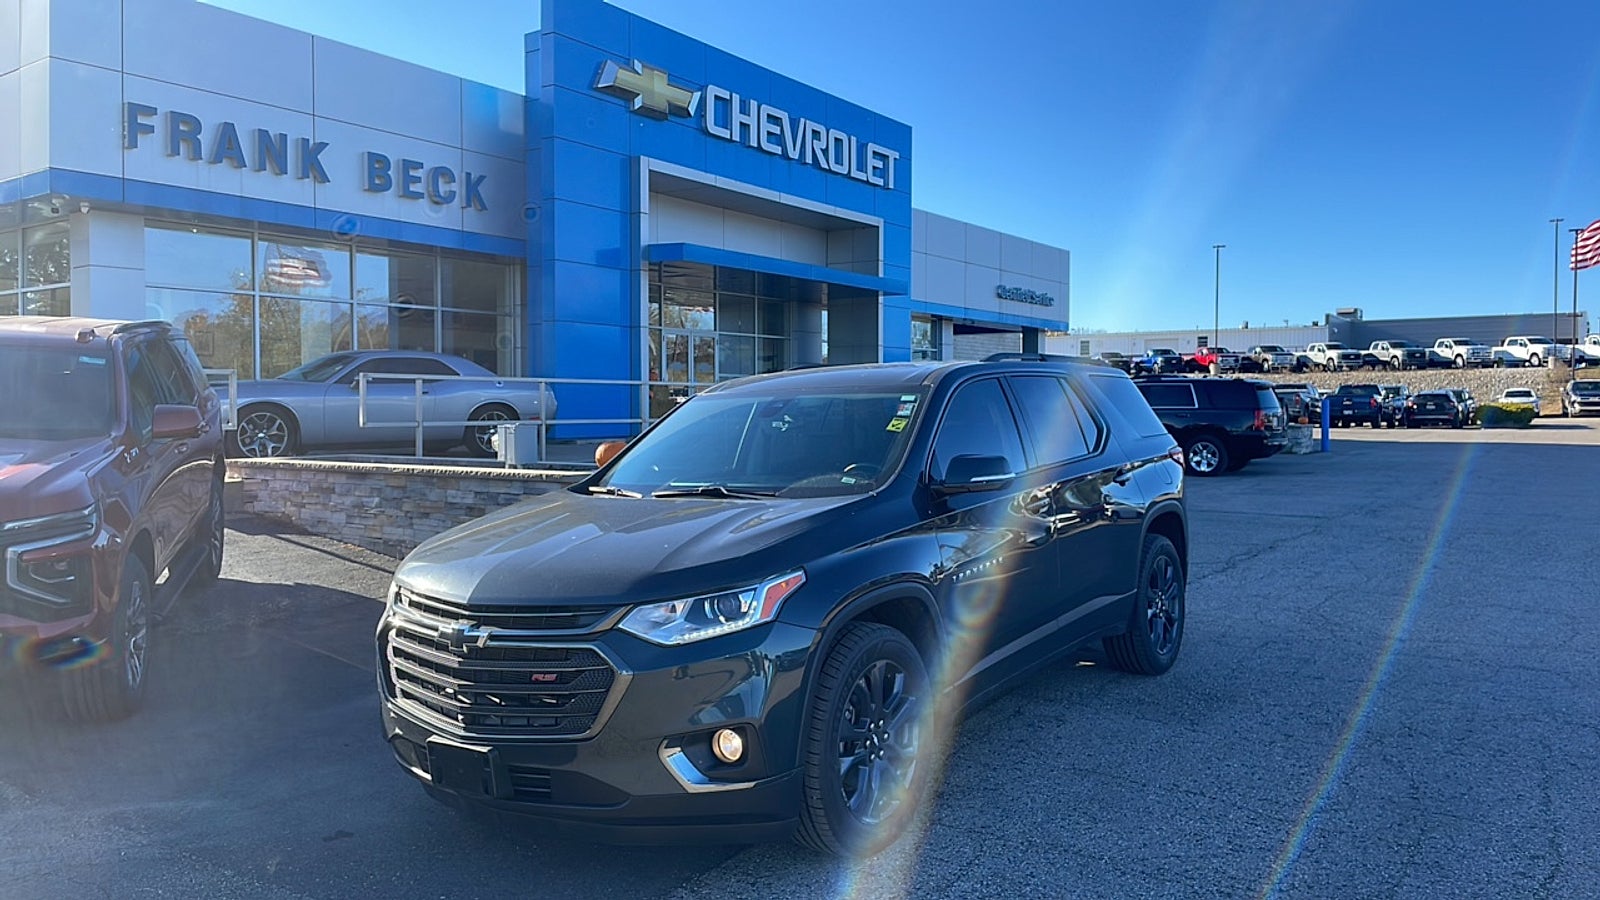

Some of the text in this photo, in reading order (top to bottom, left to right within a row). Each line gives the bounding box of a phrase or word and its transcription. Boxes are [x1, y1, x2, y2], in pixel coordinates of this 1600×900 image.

[124, 101, 489, 212] FRANK BECK
[706, 84, 900, 189] CHEVROLET
